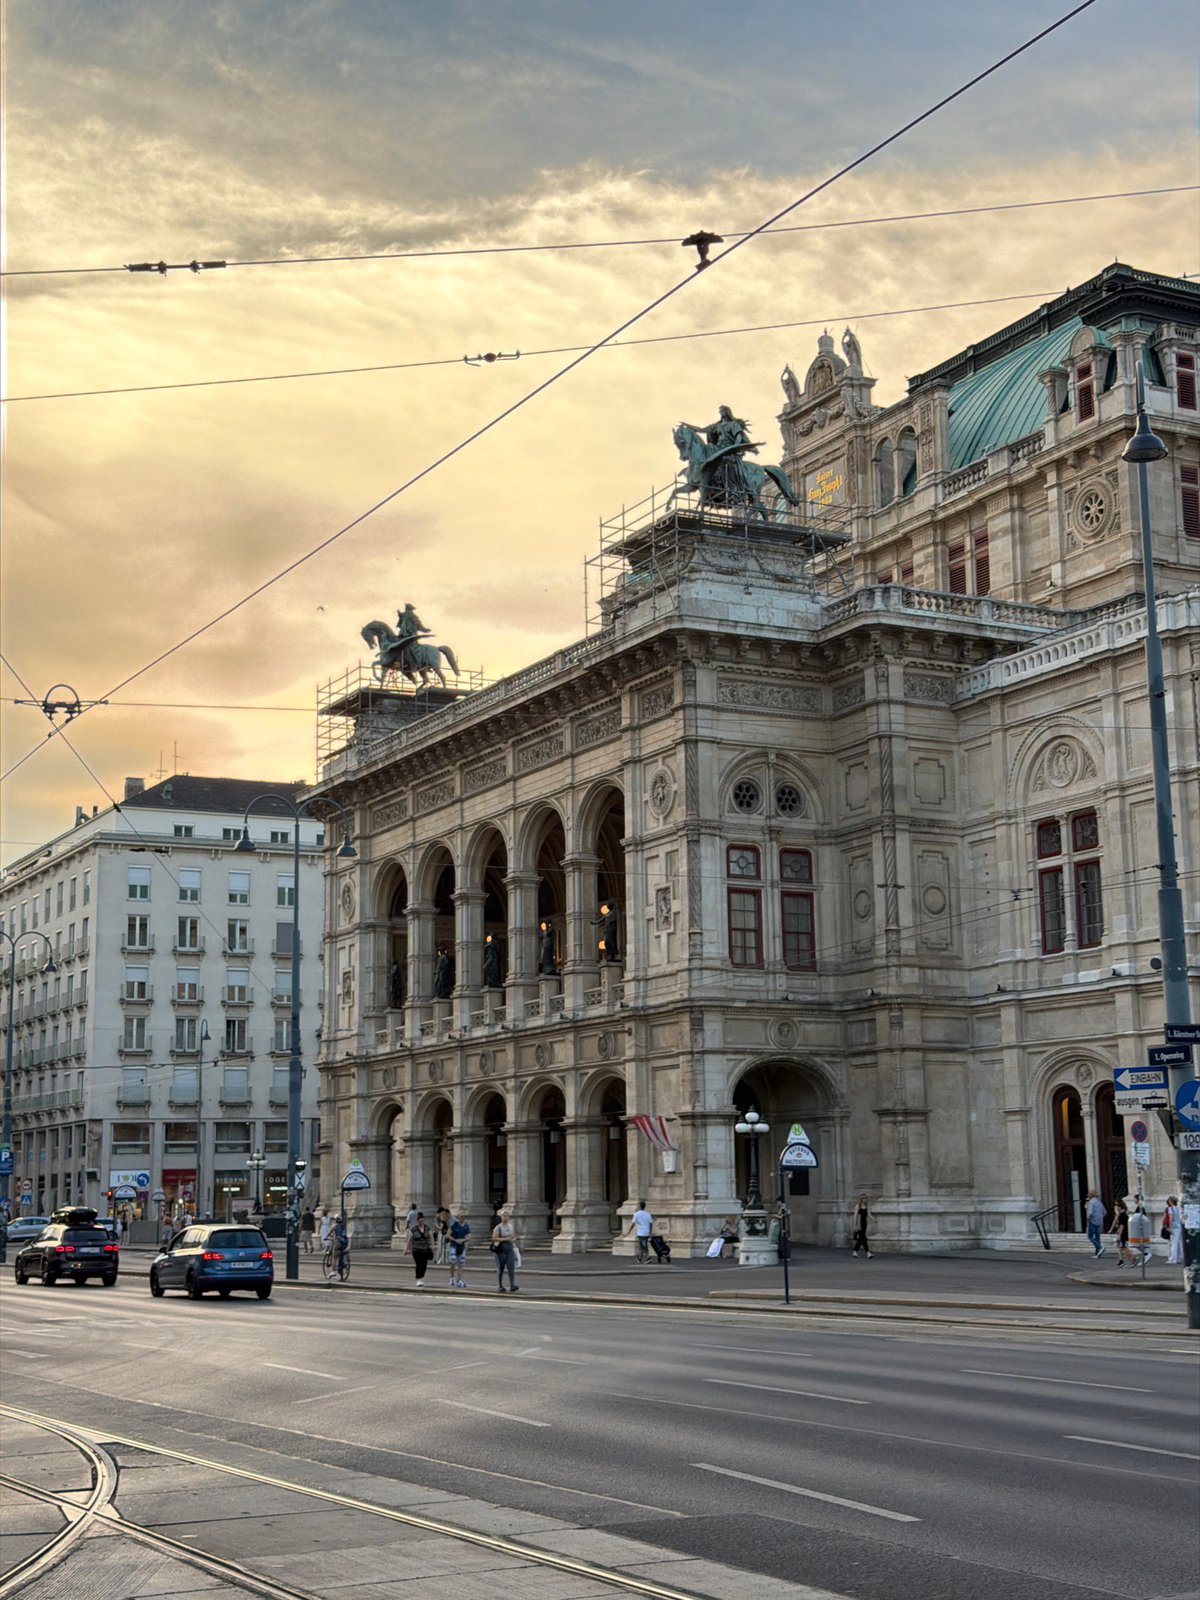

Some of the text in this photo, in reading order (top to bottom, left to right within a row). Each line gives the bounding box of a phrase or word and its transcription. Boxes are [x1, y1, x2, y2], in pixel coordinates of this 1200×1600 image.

[1130, 1073, 1162, 1084] EINBAHN
[1117, 1097, 1142, 1108] ausgen.
[1, 1151, 10, 1161] P
